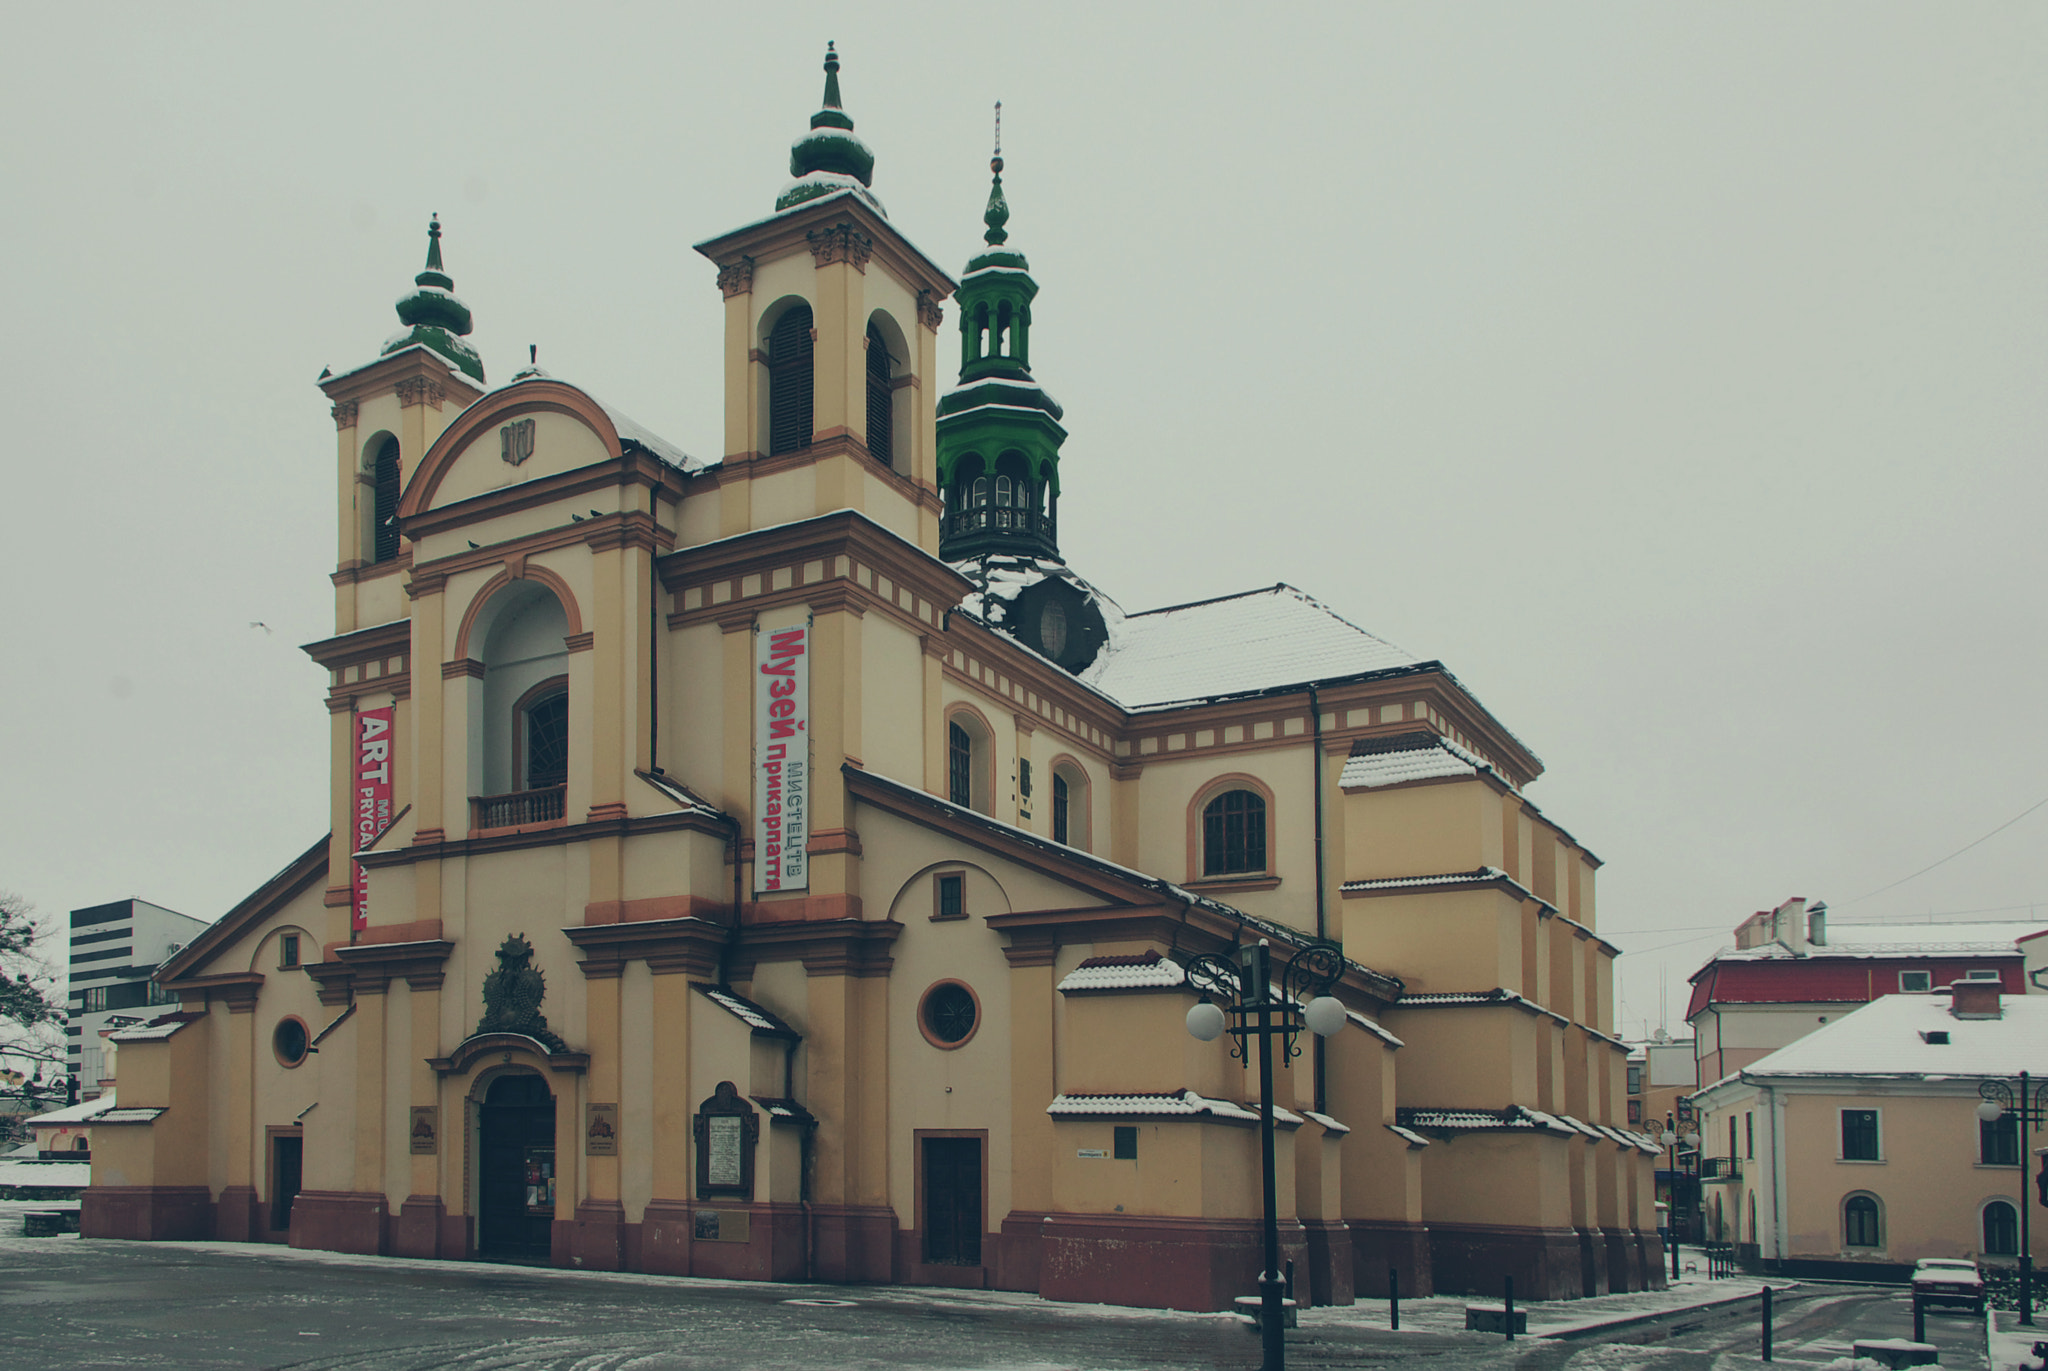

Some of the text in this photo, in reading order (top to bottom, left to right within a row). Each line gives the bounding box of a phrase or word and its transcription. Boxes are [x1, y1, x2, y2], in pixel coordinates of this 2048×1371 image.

[761, 629, 805, 740] Музей
[361, 716, 388, 785] ART
[762, 743, 787, 890] Прикарпаття
[785, 761, 803, 878] МИСТЕЦТВ
